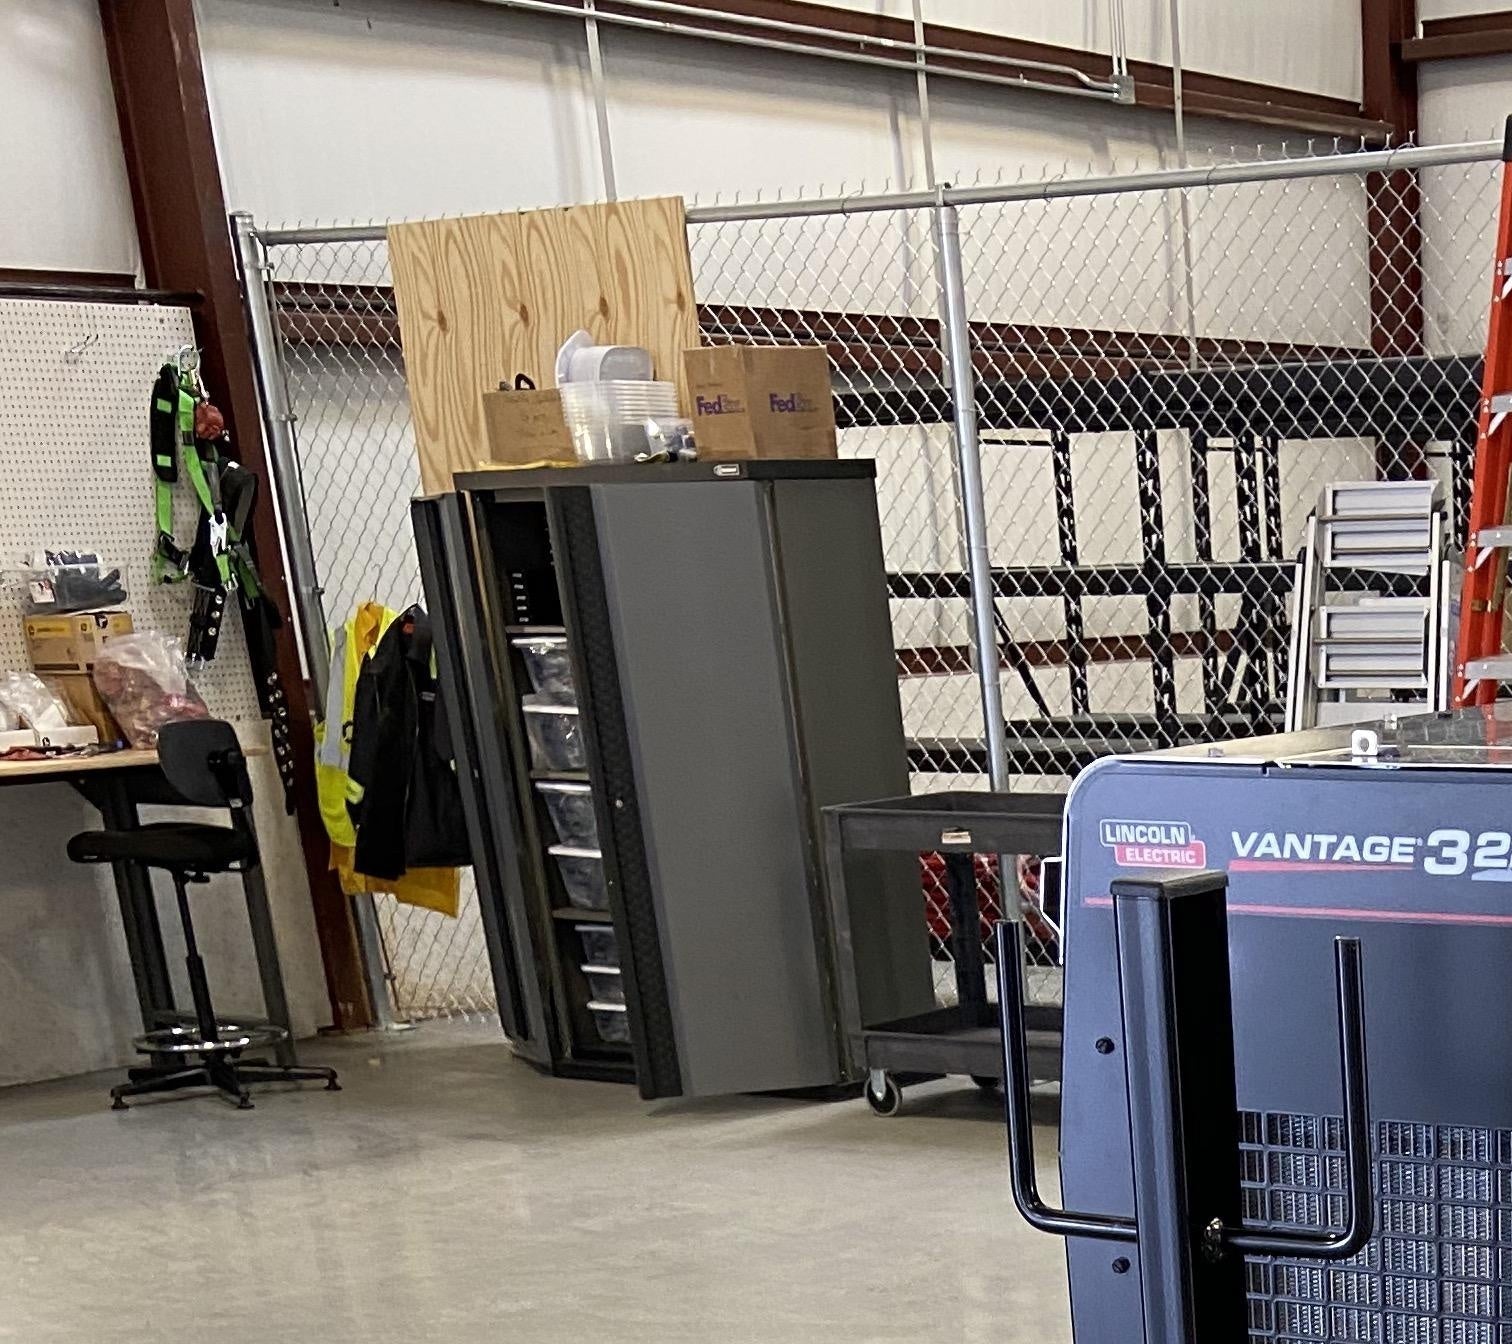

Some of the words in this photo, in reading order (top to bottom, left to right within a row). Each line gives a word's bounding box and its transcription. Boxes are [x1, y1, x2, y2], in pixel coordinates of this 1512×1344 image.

[1105, 824, 1186, 845] LINCOLN
[1126, 848, 1196, 864] ELECTRIC
[1231, 831, 1416, 863] VANTAGE
